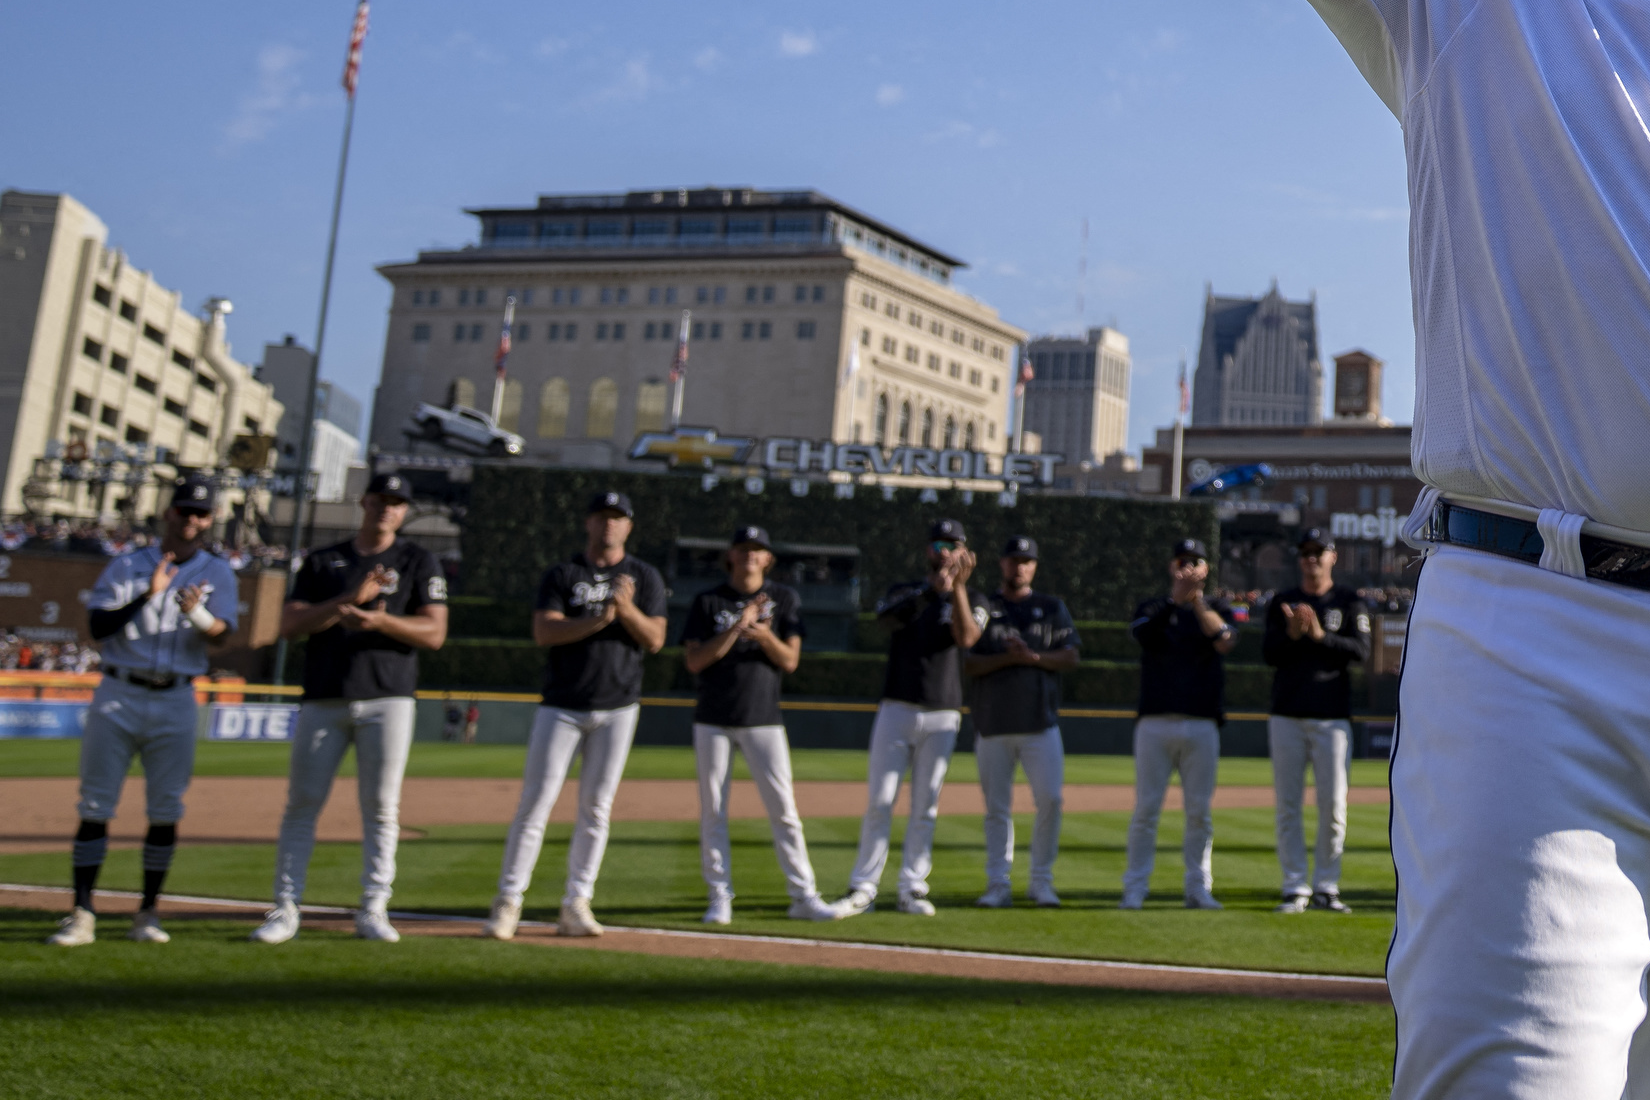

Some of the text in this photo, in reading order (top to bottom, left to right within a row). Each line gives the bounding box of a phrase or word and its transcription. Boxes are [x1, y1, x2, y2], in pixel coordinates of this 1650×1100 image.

[764, 438, 1066, 487] CHEVROLET
[701, 473, 1019, 508] FOUNTAIN
[217, 707, 291, 740] DTE
